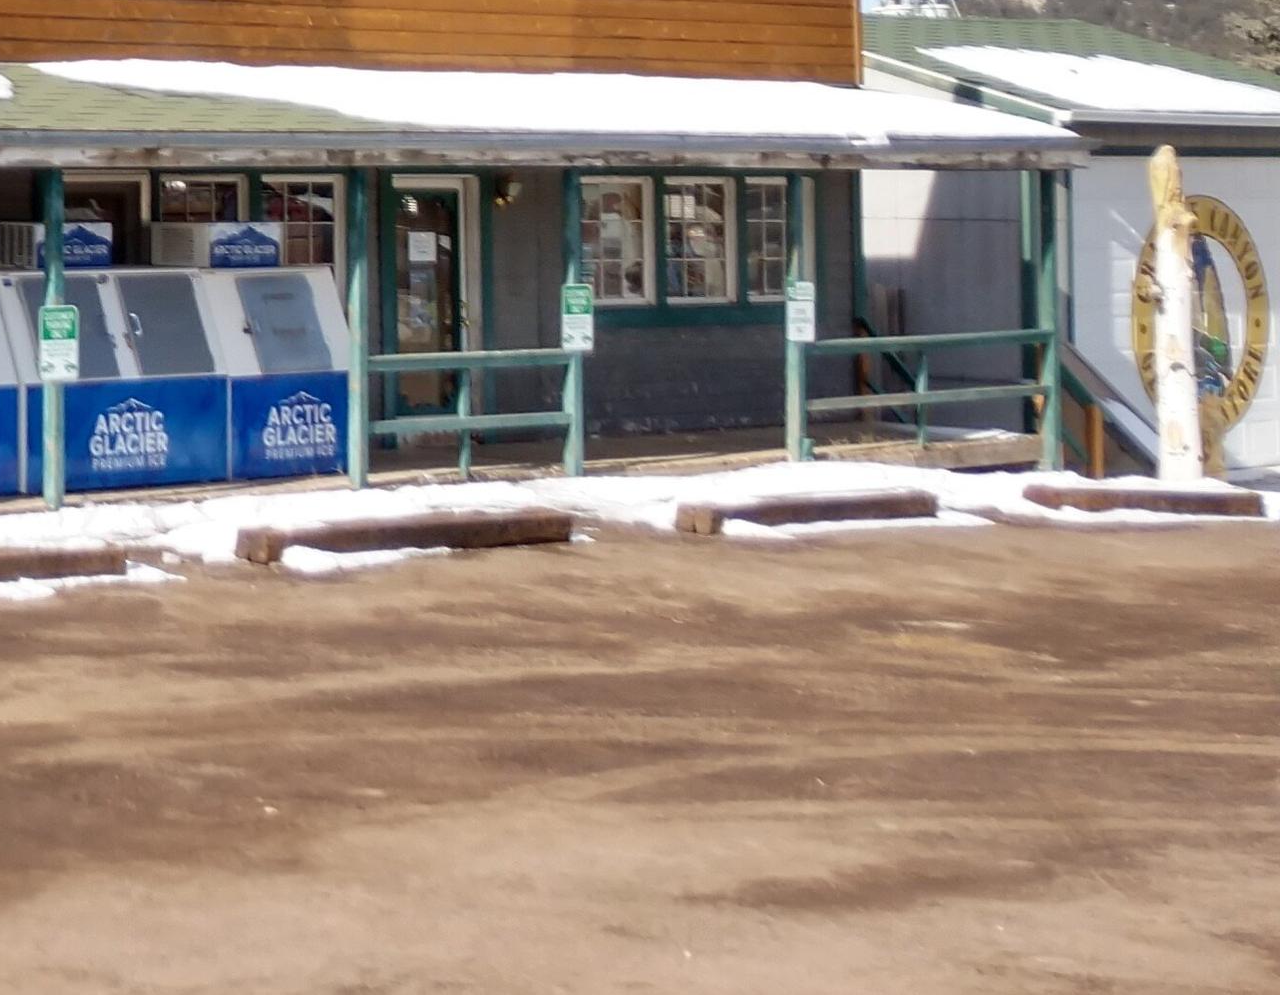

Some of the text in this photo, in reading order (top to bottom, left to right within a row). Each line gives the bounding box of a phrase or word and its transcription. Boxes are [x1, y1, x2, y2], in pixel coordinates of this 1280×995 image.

[94, 410, 165, 435] ARCTIC
[267, 402, 332, 426] ARCTIC
[88, 431, 169, 457] GLACIER
[262, 423, 337, 448] GLACIER
